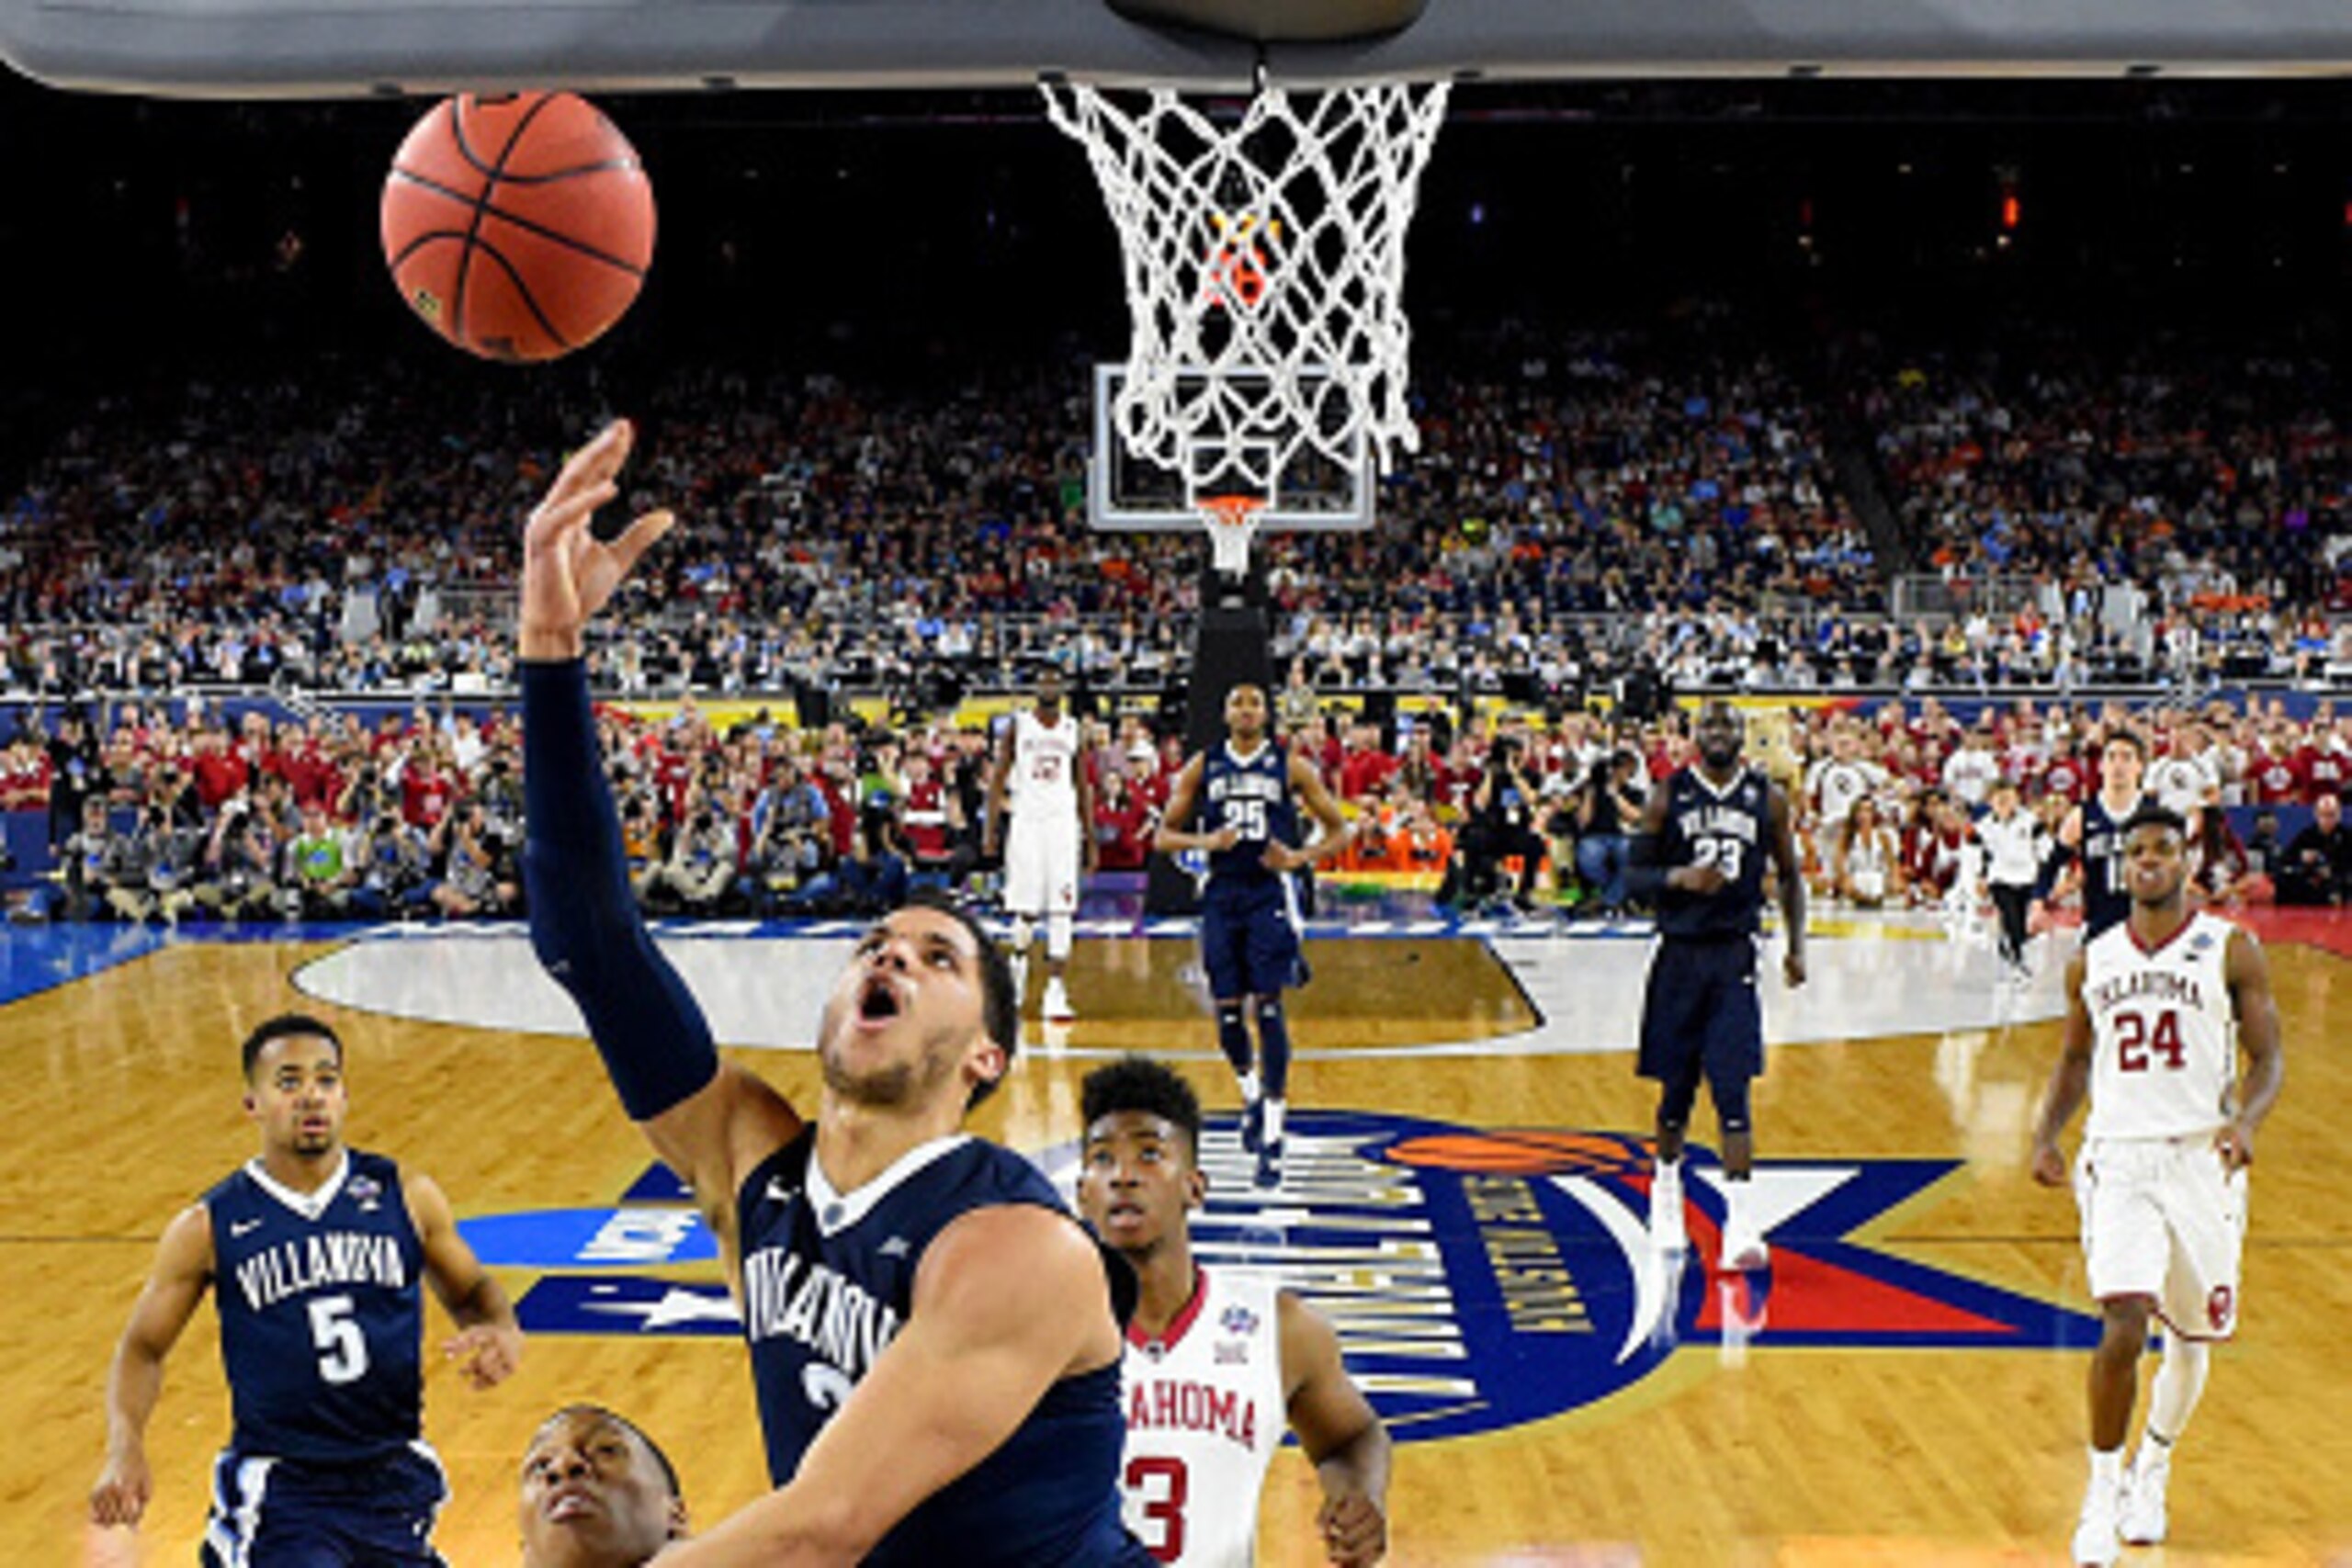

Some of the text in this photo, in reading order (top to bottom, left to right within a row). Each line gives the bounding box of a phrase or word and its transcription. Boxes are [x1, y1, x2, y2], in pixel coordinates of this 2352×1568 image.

[1223, 800, 1267, 840] 25
[1692, 838, 1740, 881] 23
[2114, 1010, 2187, 1072] 24
[236, 1231, 405, 1314] VILLANOVA
[307, 1293, 369, 1385] 5
[1125, 1457, 1188, 1565] 3
